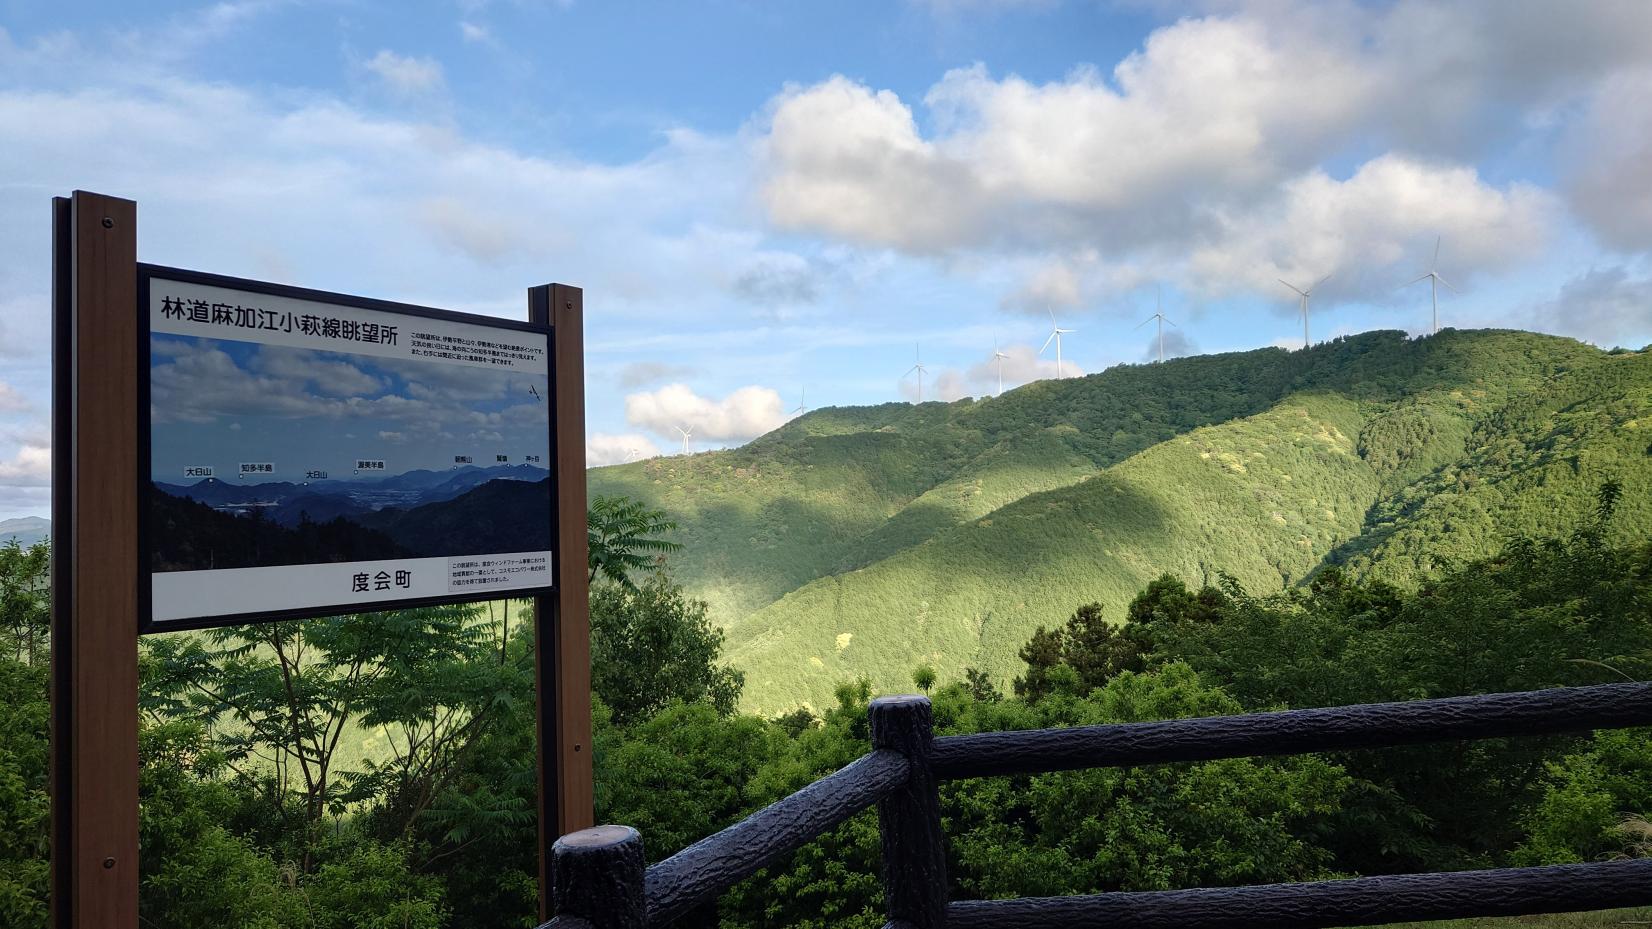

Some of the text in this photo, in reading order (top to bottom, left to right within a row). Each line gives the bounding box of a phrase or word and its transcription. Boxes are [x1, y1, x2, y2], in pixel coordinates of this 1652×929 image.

[161, 295, 399, 346] 林道麻加江小萩線眺望所
[186, 467, 213, 477] 大日山
[241, 463, 273, 473] 知多半島
[306, 470, 328, 479] 大日山
[352, 570, 412, 593] 度会町
